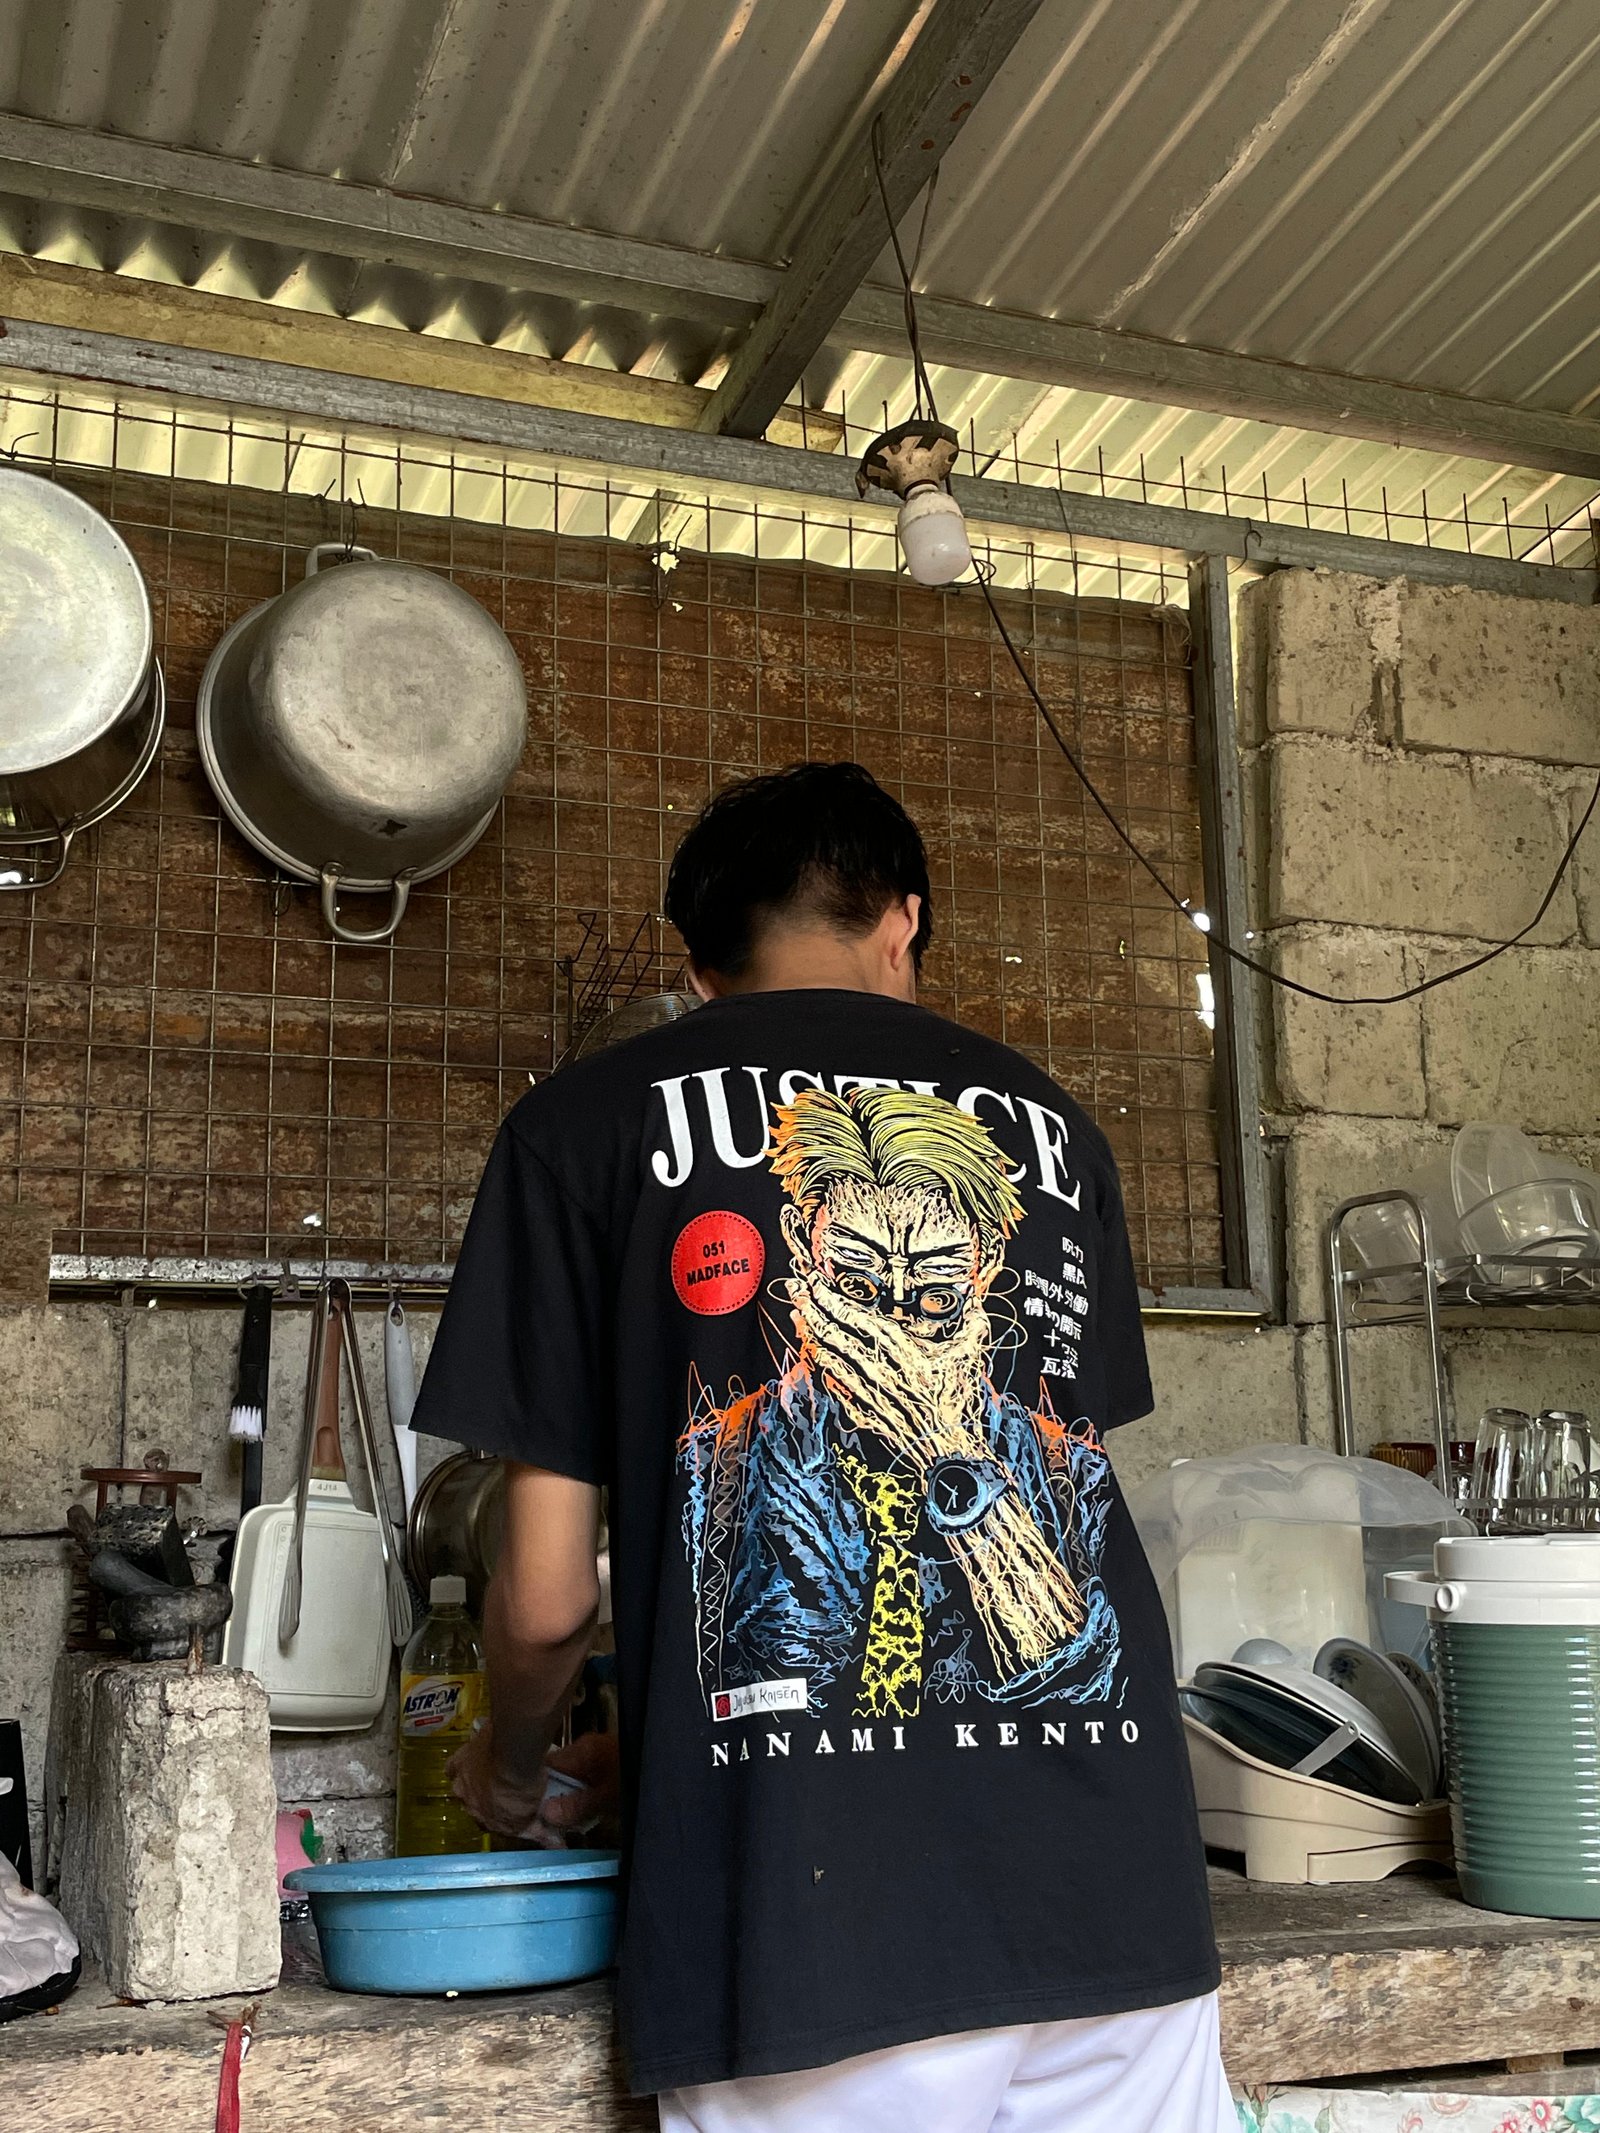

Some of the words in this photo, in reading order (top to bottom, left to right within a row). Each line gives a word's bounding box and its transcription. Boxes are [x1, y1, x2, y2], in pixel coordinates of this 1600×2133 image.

[651, 1066, 1081, 1211] JUCE
[702, 1241, 725, 1258] 051
[686, 1258, 750, 1286] MADFACE
[403, 1687, 460, 1714] ASTRON
[711, 1726, 906, 1767] NANAMI
[954, 1719, 1140, 1748] KENTO
